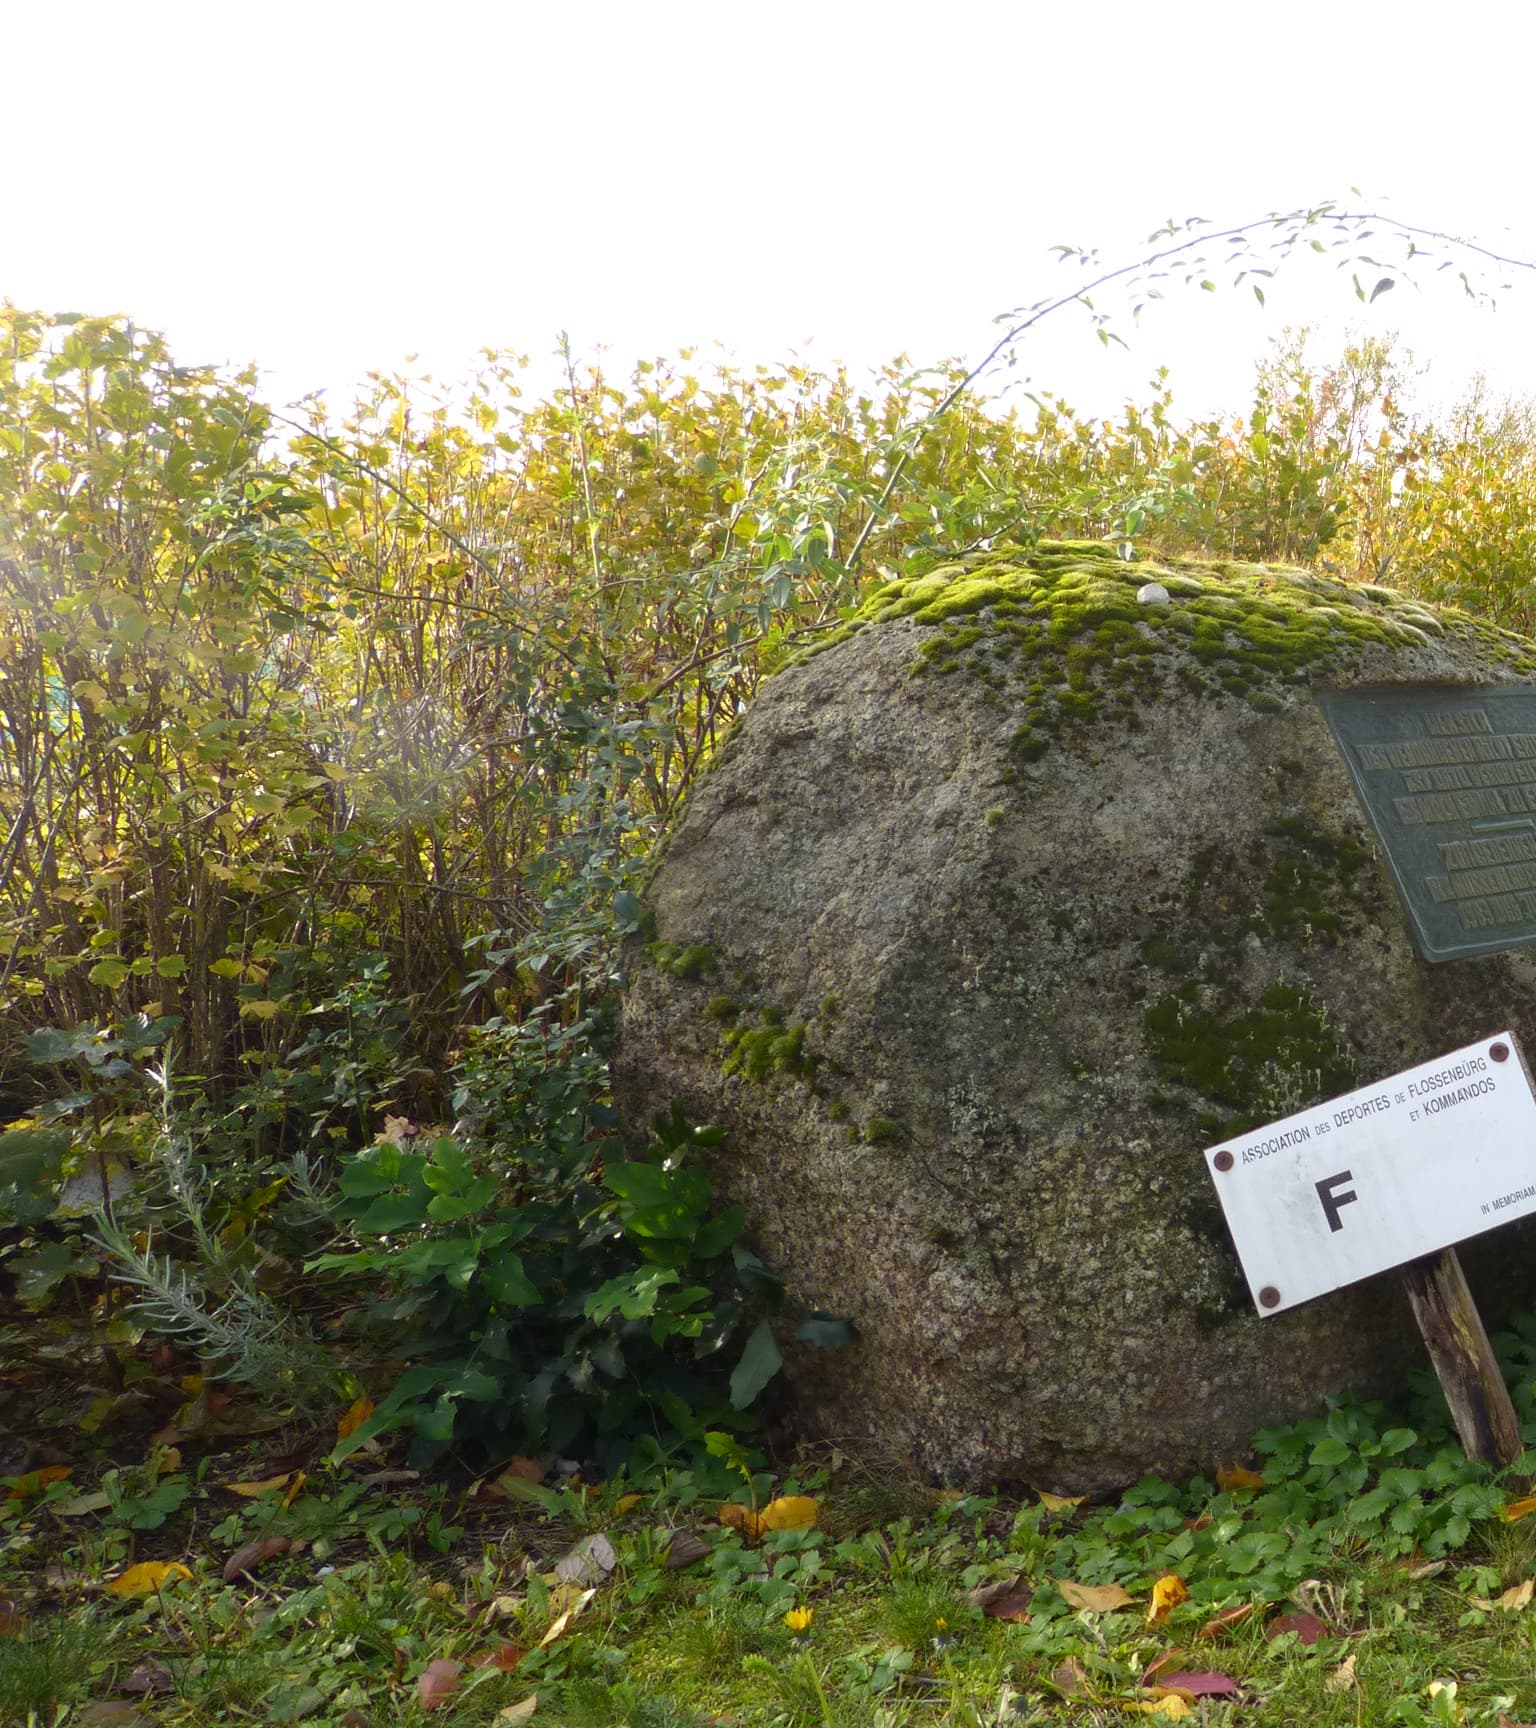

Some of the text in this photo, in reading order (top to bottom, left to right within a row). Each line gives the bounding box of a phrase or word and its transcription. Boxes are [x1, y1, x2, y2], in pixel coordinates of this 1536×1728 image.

[1409, 1077, 1496, 1122] ET KOMMANDOS
[1242, 1126, 1311, 1164] ASSOCIATION
[1314, 1122, 1331, 1136] DES
[1333, 1095, 1391, 1128] DEPORTES
[1394, 1092, 1406, 1104] DE
[1314, 1169, 1358, 1233] F
[1480, 1185, 1536, 1215] IN MEMORIAM
